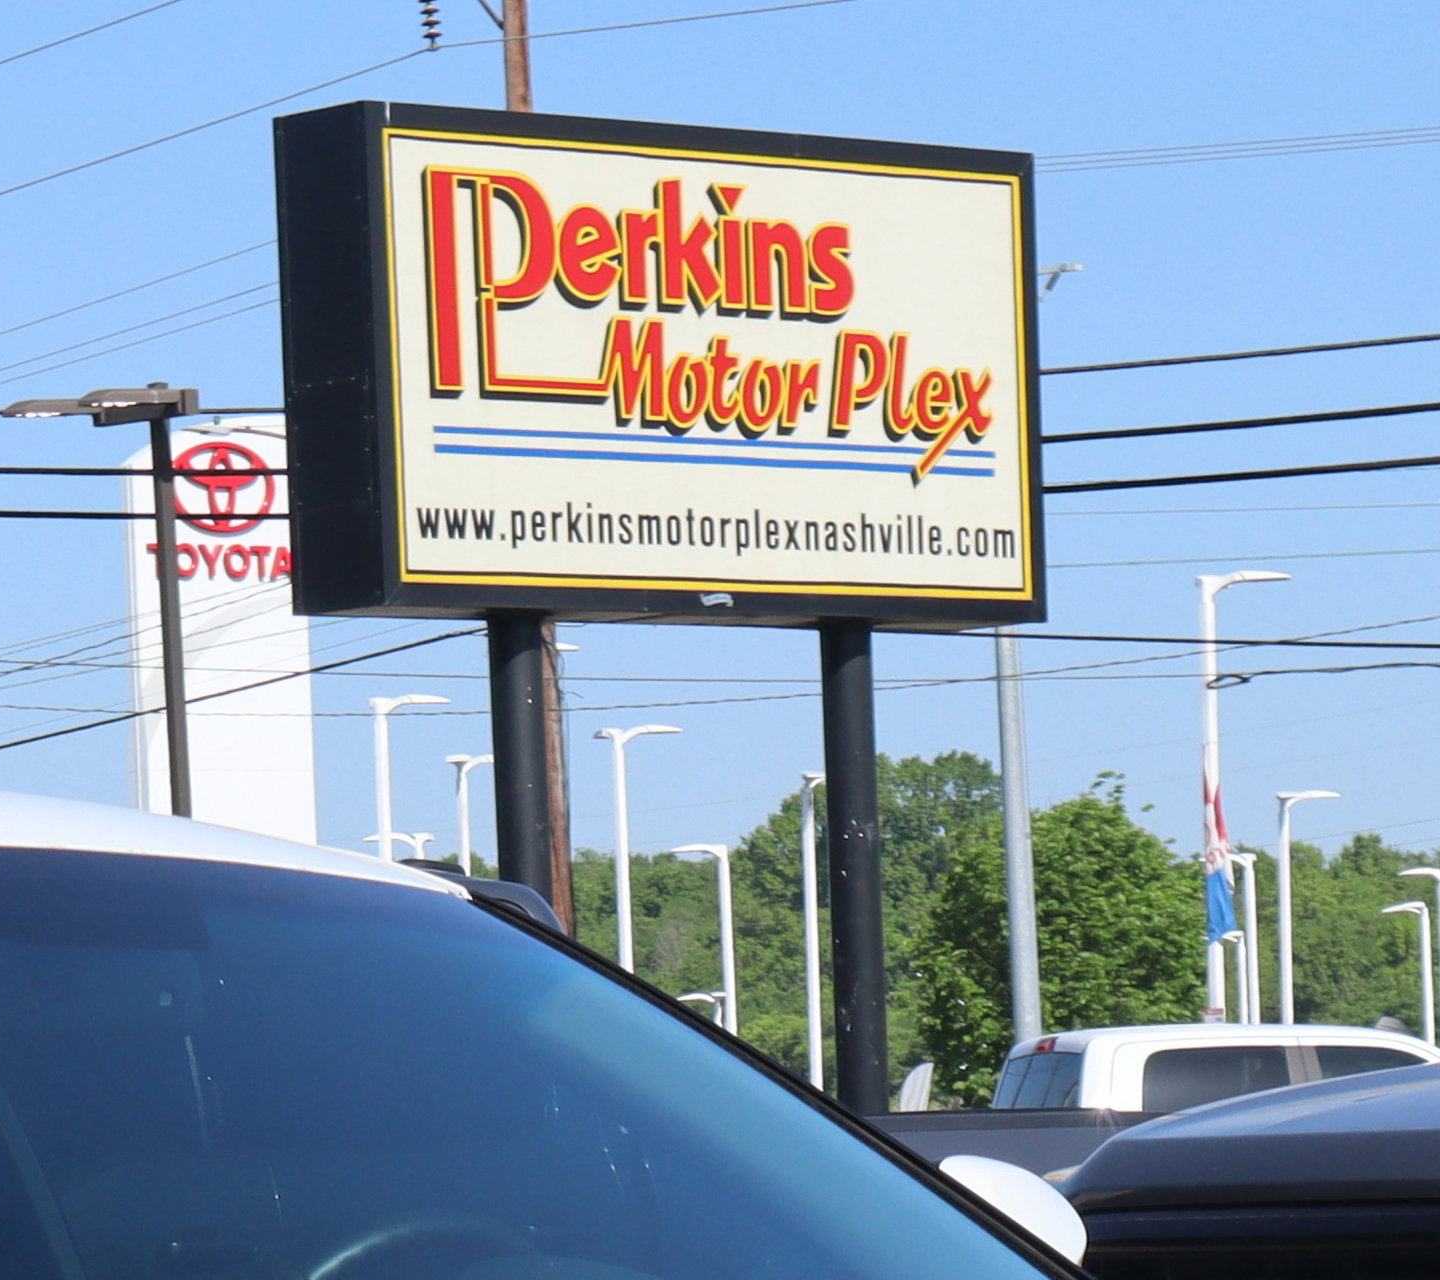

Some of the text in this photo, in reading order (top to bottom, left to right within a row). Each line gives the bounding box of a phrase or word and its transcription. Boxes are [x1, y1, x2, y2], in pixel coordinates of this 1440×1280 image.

[423, 165, 855, 396] Perkins
[607, 317, 994, 483] Motor Plex
[415, 501, 1016, 559] www.perkinsmotorplexnashville.com
